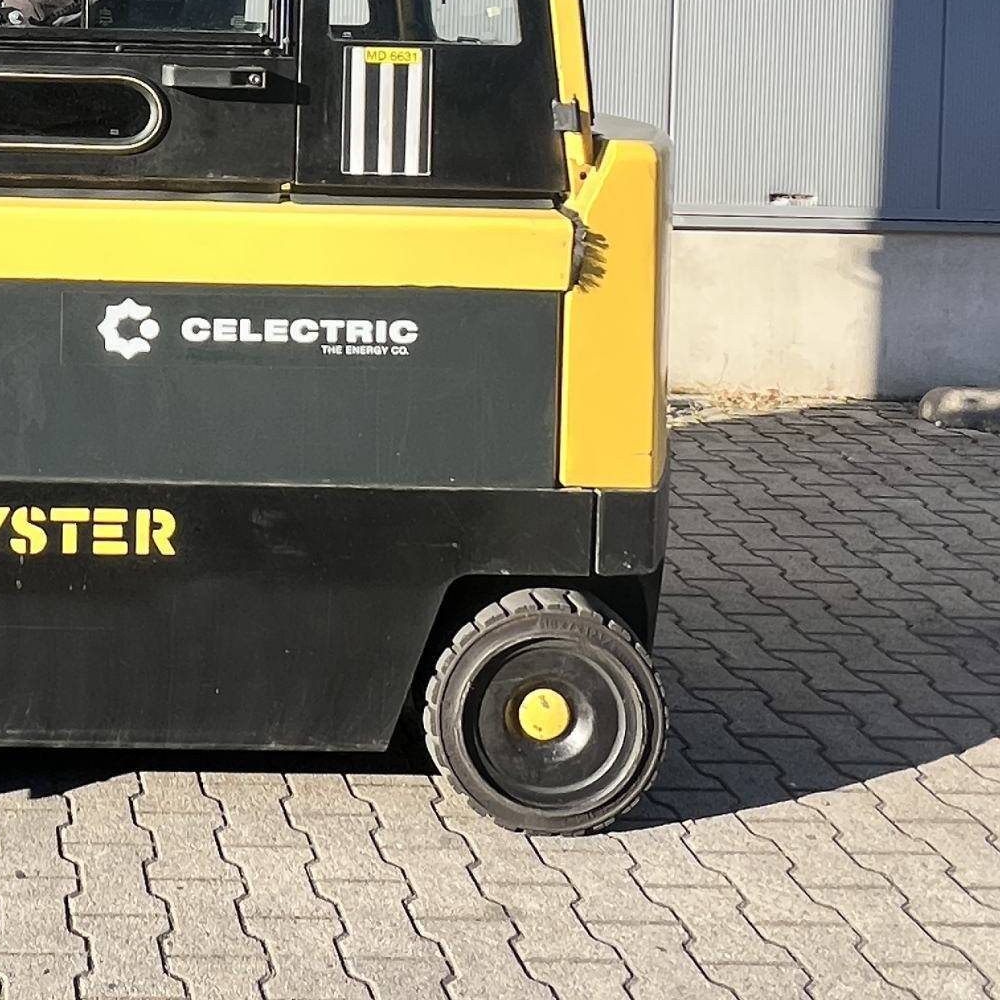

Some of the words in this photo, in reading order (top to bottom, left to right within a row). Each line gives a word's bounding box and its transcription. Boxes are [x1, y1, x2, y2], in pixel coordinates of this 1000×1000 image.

[366, 50, 387, 61] MD
[390, 51, 417, 62] 6631
[181, 317, 419, 344] CELECTRIC
[320, 344, 343, 355] THE
[345, 345, 388, 356] ENERGY
